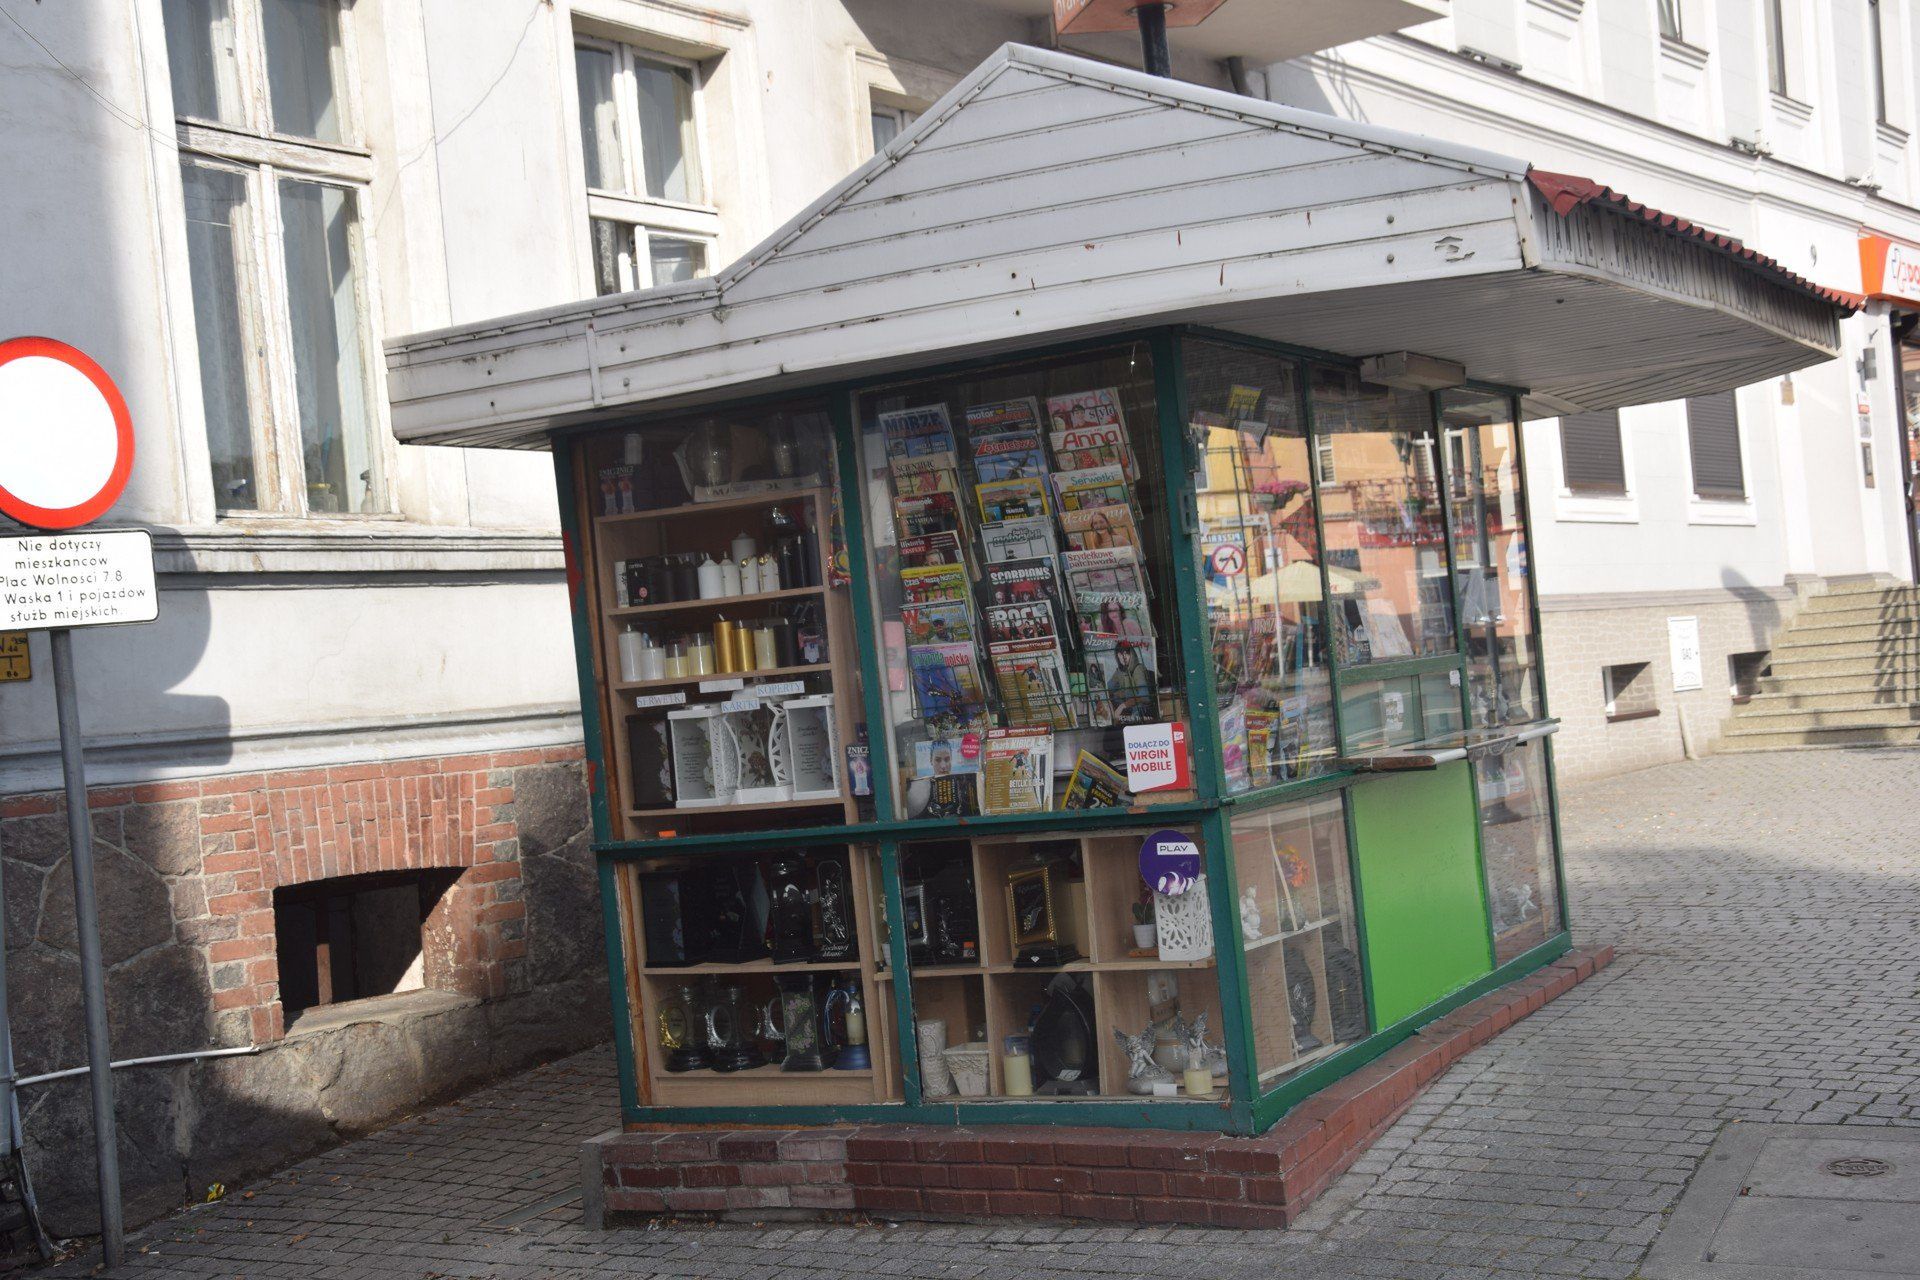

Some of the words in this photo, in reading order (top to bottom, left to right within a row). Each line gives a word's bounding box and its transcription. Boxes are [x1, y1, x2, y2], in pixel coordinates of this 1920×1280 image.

[967, 409, 994, 420] motor
[1062, 430, 1119, 450] Anna
[1071, 473, 1115, 486] Serwetki
[19, 541, 43, 552] Nie
[50, 539, 101, 552] dotyczy
[1068, 551, 1114, 562] Szydełkowe
[990, 567, 1051, 585] SCORPIONS
[58, 591, 64, 603] 1
[11, 610, 48, 623] służb
[54, 606, 119, 621] miejskich
[994, 606, 1050, 629] ROCK
[757, 683, 803, 696] KOPERTY
[637, 694, 685, 707] SERWETKI
[722, 701, 759, 713] KARTKI
[847, 746, 869, 754] ZNICZ
[1129, 741, 1156, 749] DOŁĄCZ
[1130, 749, 1169, 761] VIRGIN
[1131, 761, 1172, 773] MOBILE
